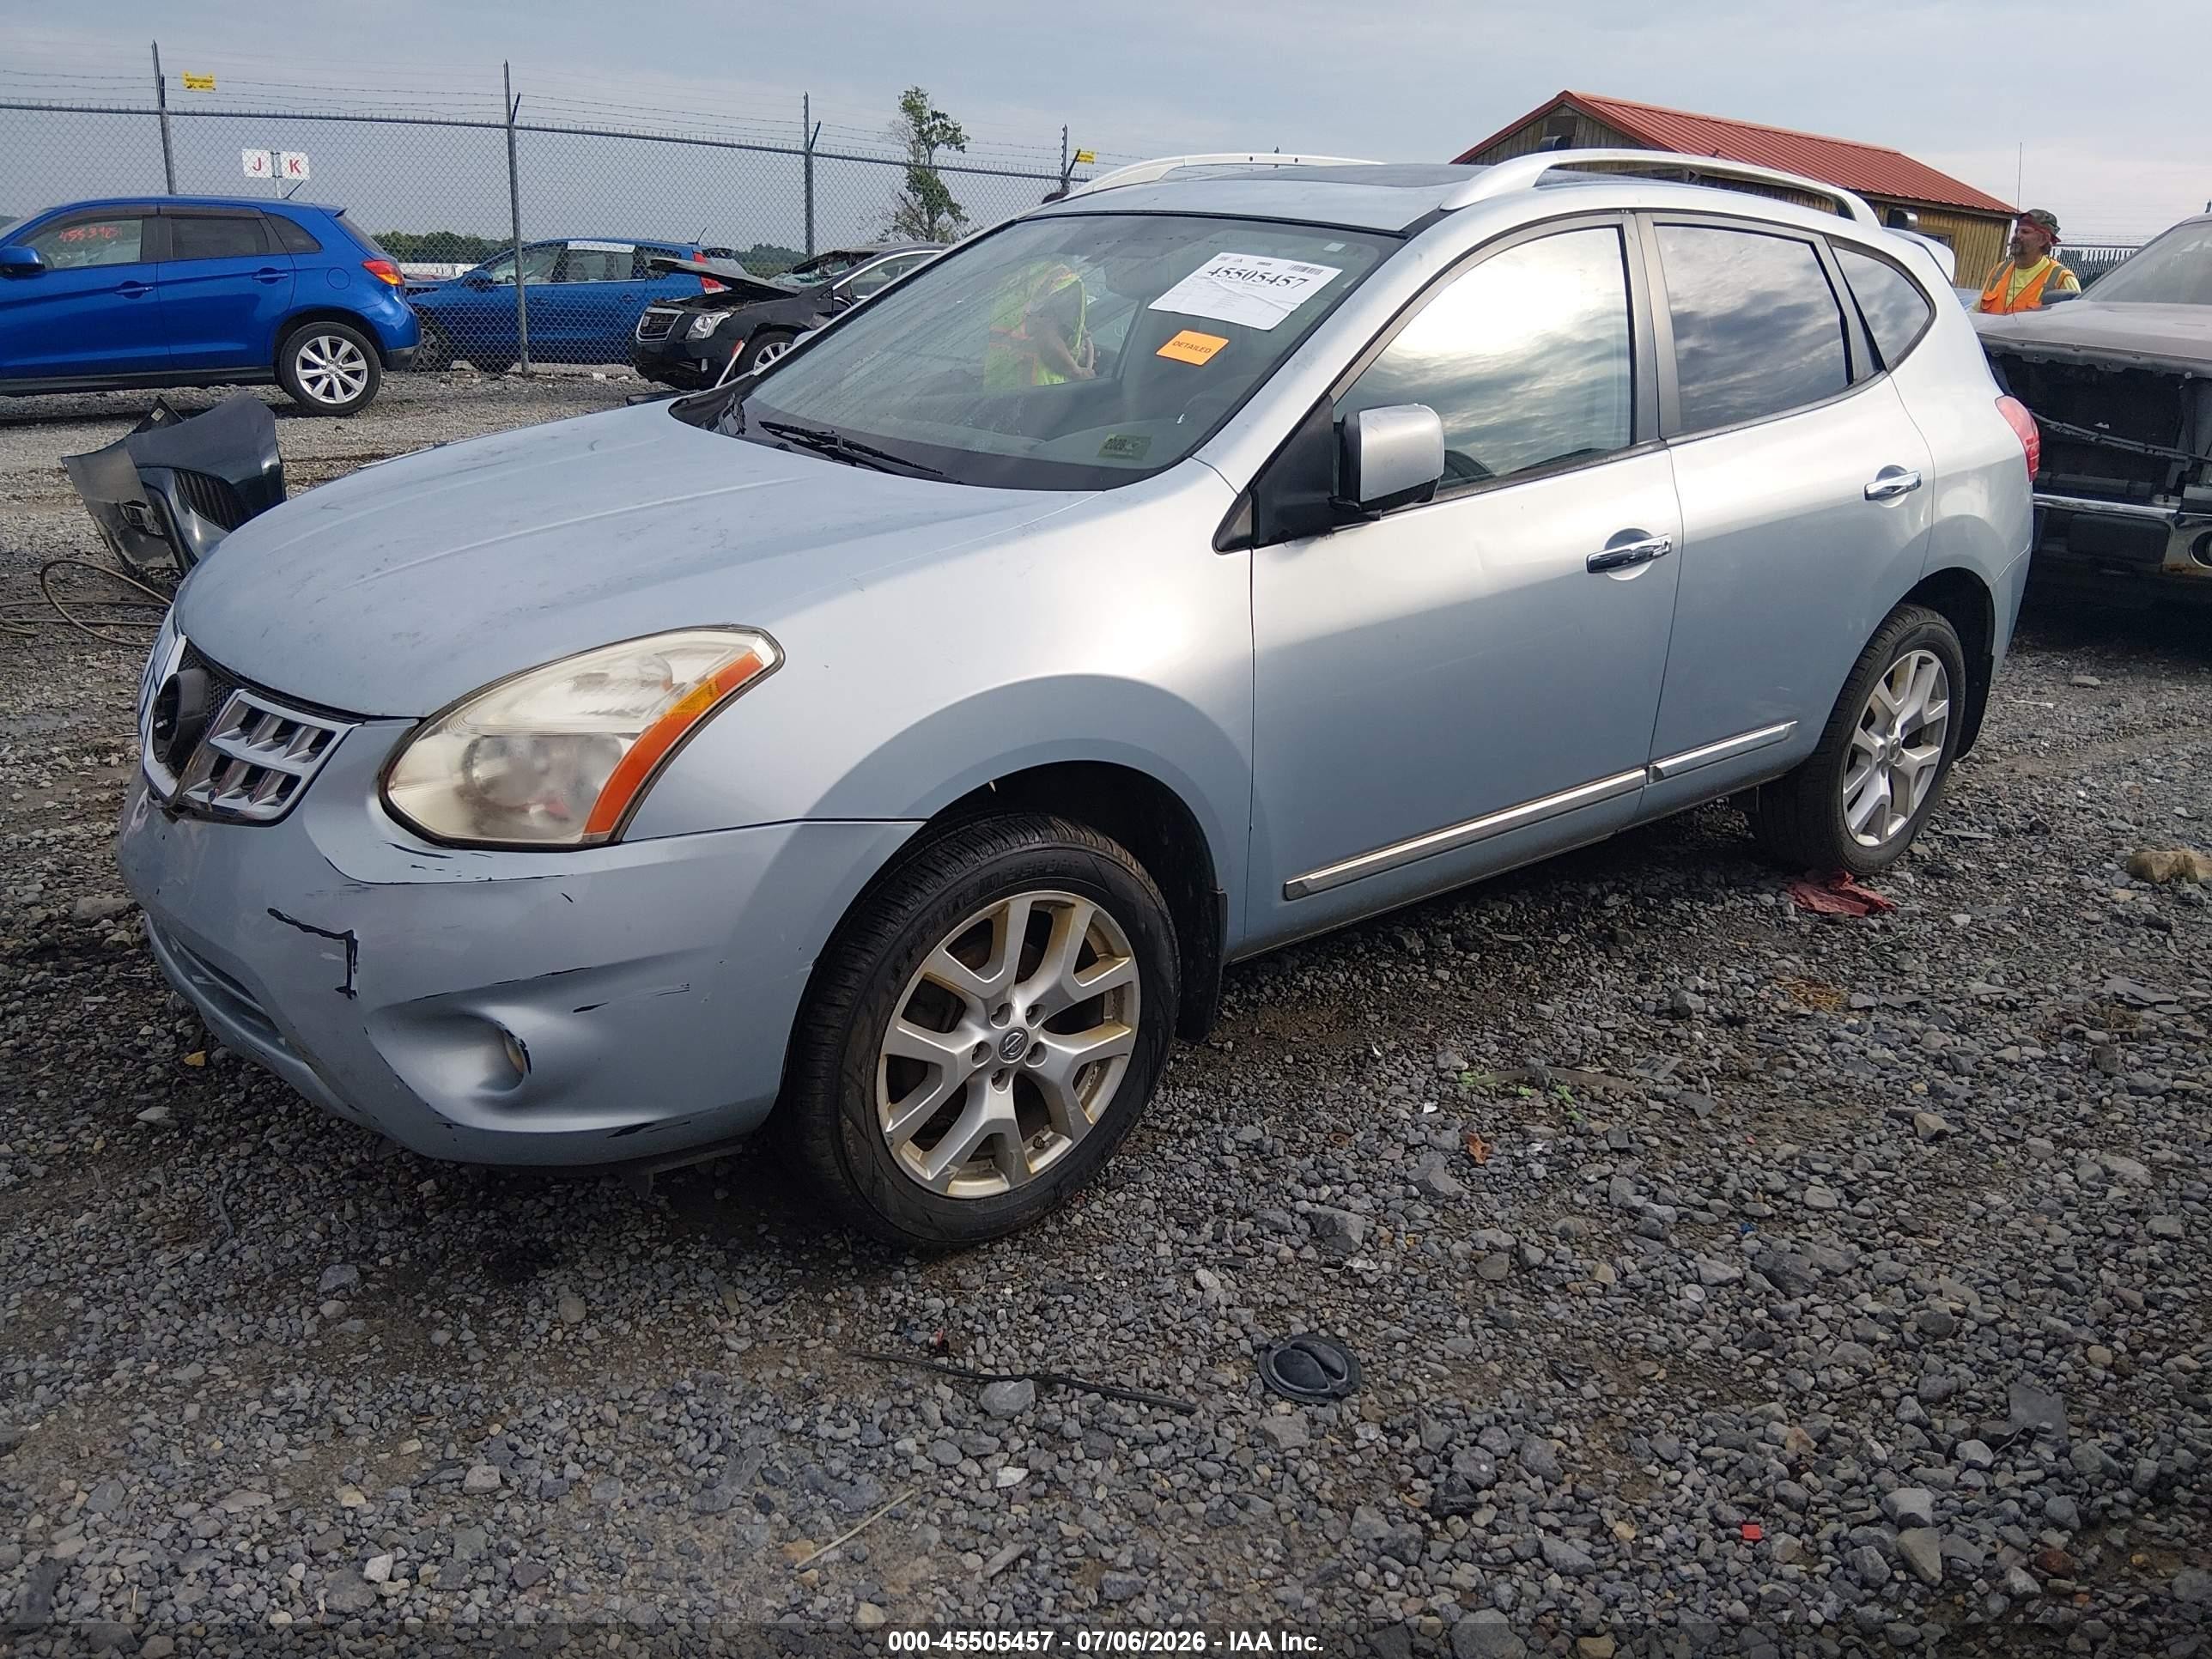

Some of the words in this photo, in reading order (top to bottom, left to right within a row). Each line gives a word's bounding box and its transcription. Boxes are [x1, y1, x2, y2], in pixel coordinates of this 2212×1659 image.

[252, 156, 262, 172] J
[289, 158, 302, 174] K
[1206, 264, 1310, 290] 45505457
[1172, 340, 1212, 354] DETAILED
